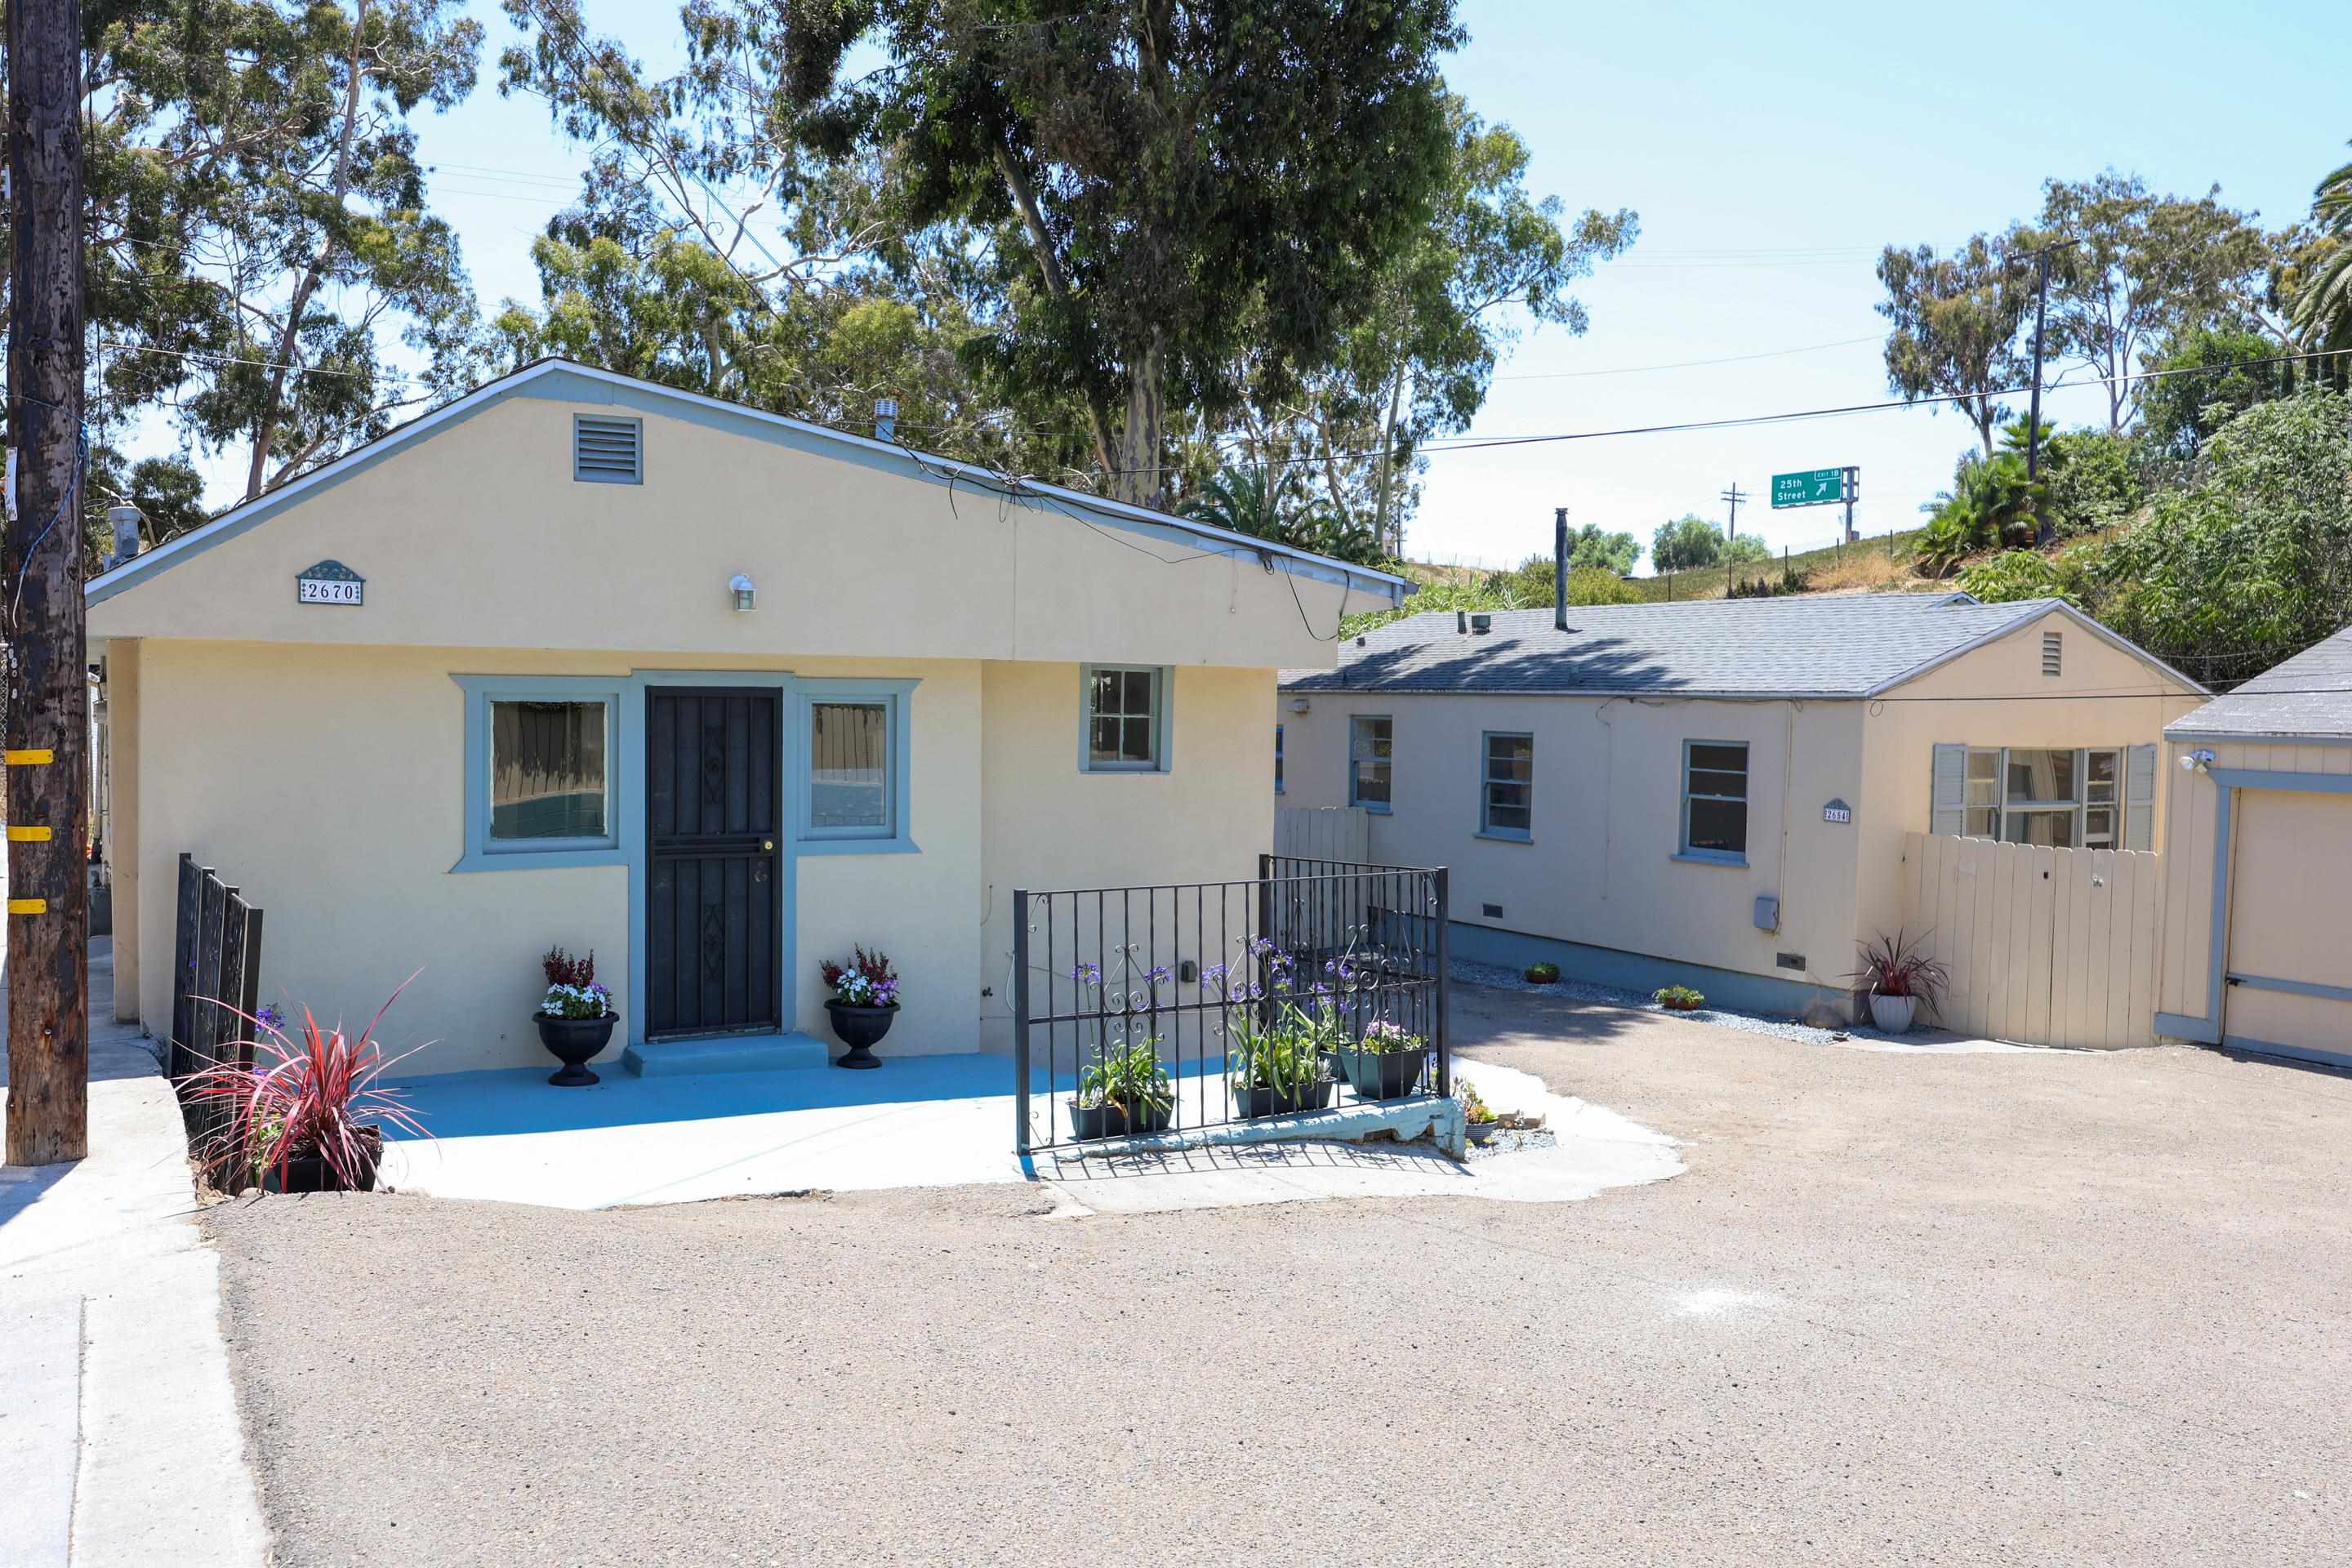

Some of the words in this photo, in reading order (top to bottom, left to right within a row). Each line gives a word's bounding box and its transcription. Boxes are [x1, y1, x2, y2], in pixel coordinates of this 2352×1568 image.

[1780, 479, 1802, 489] 25th
[1778, 490, 1806, 501] Street
[309, 583, 353, 599] 2670
